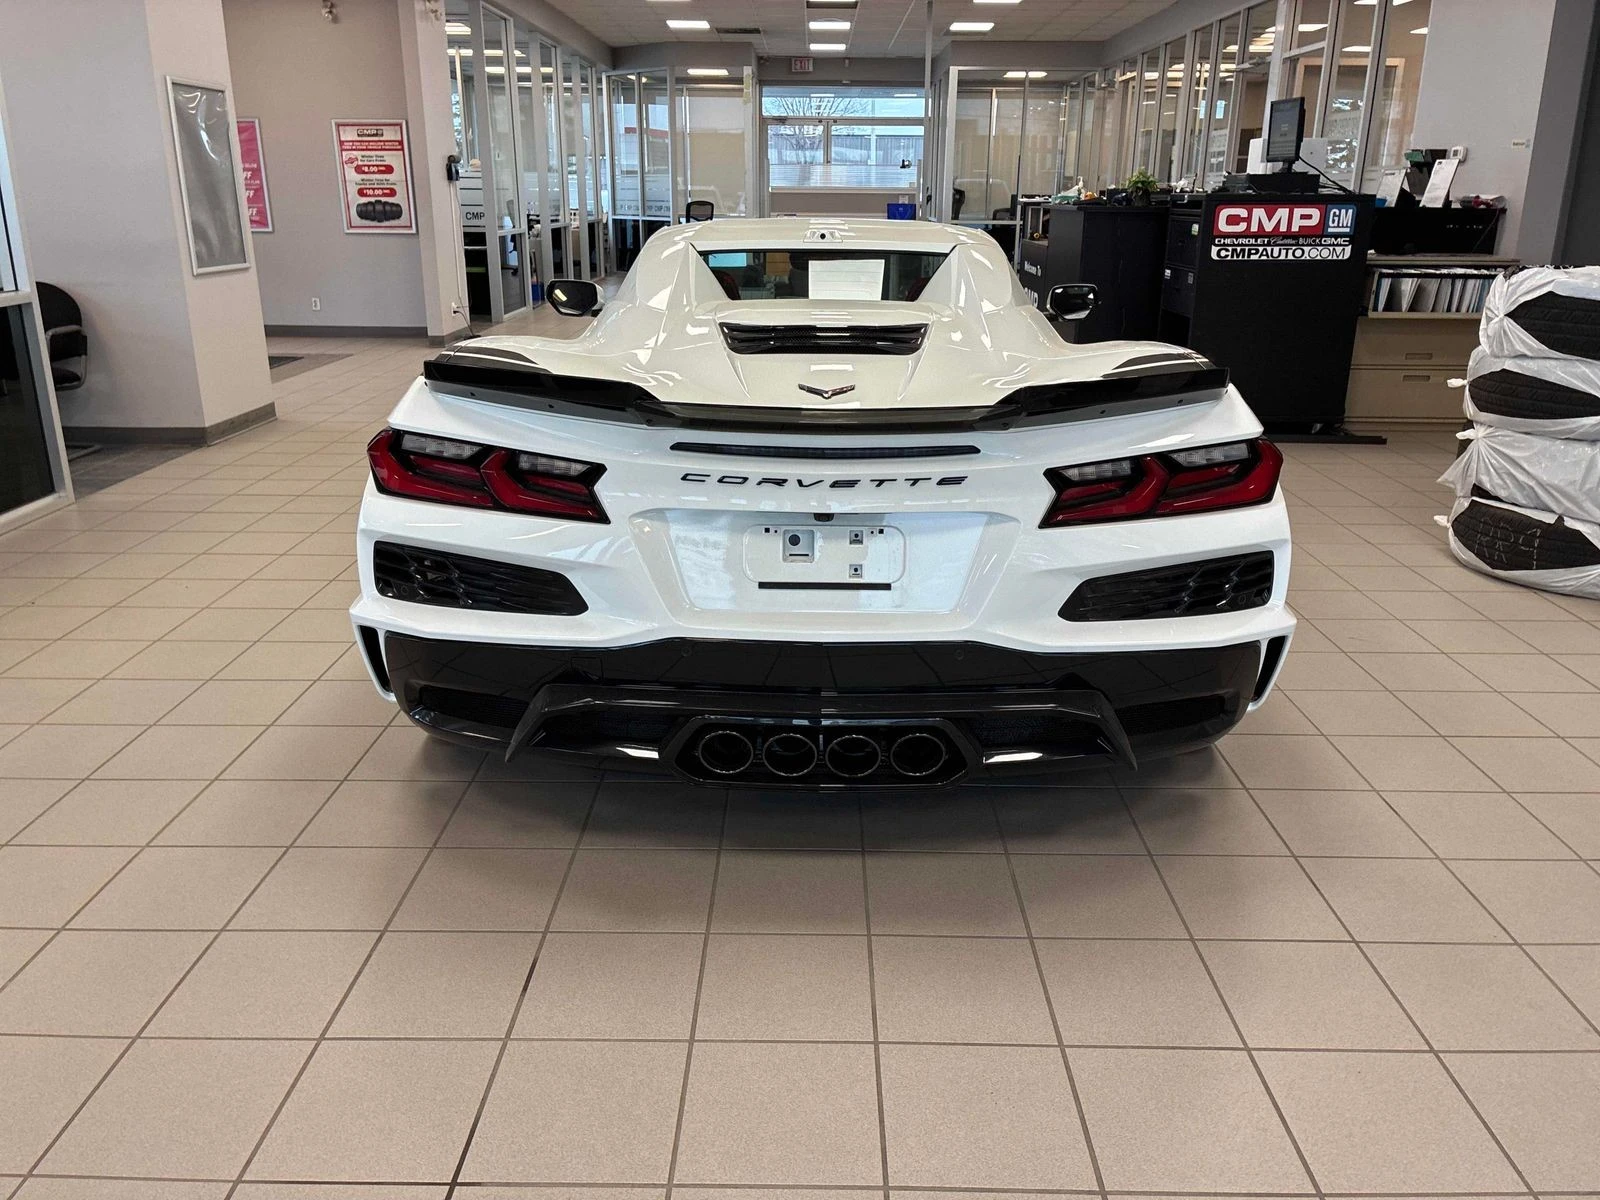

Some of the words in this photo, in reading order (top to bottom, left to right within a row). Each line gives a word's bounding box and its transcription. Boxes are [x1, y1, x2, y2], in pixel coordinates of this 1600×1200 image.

[794, 59, 811, 71] EXIT
[465, 212, 485, 220] CMP
[1218, 208, 1321, 233] CMP
[1328, 209, 1353, 227] GM
[1216, 247, 1345, 259] CMPAUTO.COM
[680, 472, 968, 489] CORVETTE
